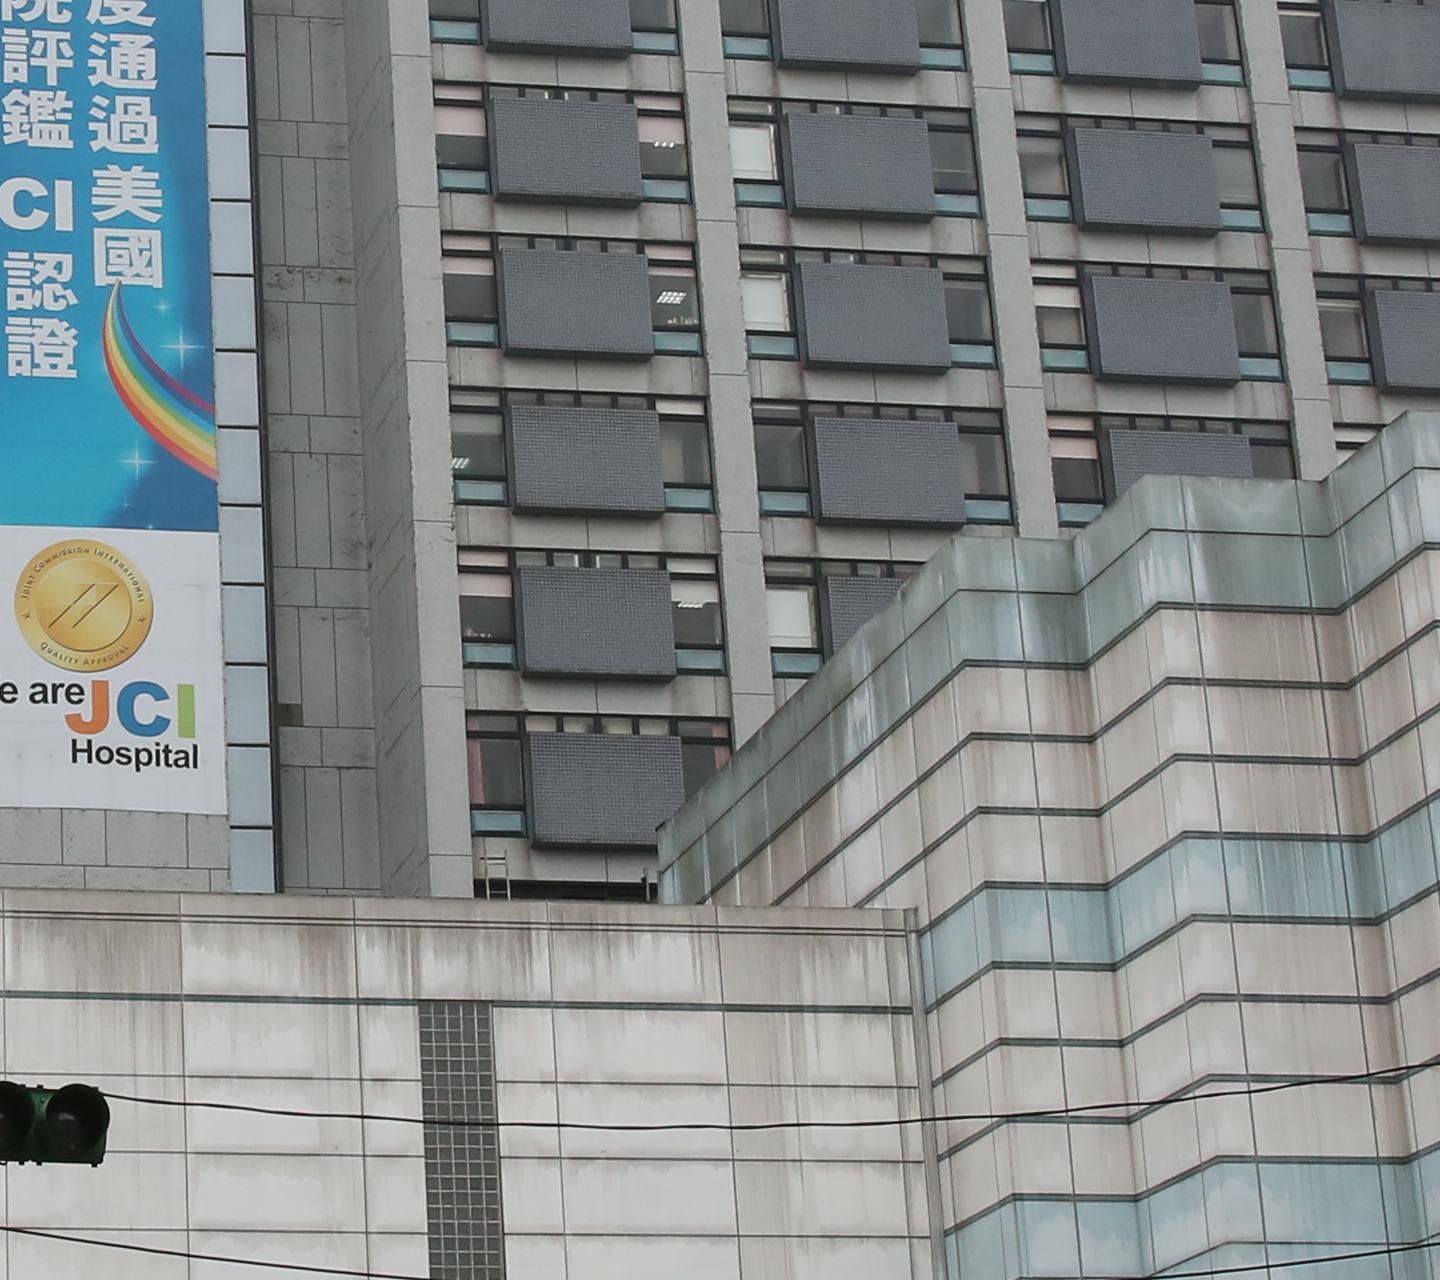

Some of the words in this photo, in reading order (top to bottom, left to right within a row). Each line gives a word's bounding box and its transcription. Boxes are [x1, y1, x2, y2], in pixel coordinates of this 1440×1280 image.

[3, 250, 79, 380] 認證
[40, 641, 79, 664] QUALITY
[28, 679, 86, 705] are
[64, 680, 196, 739] JCI
[70, 738, 199, 773] Hospital
